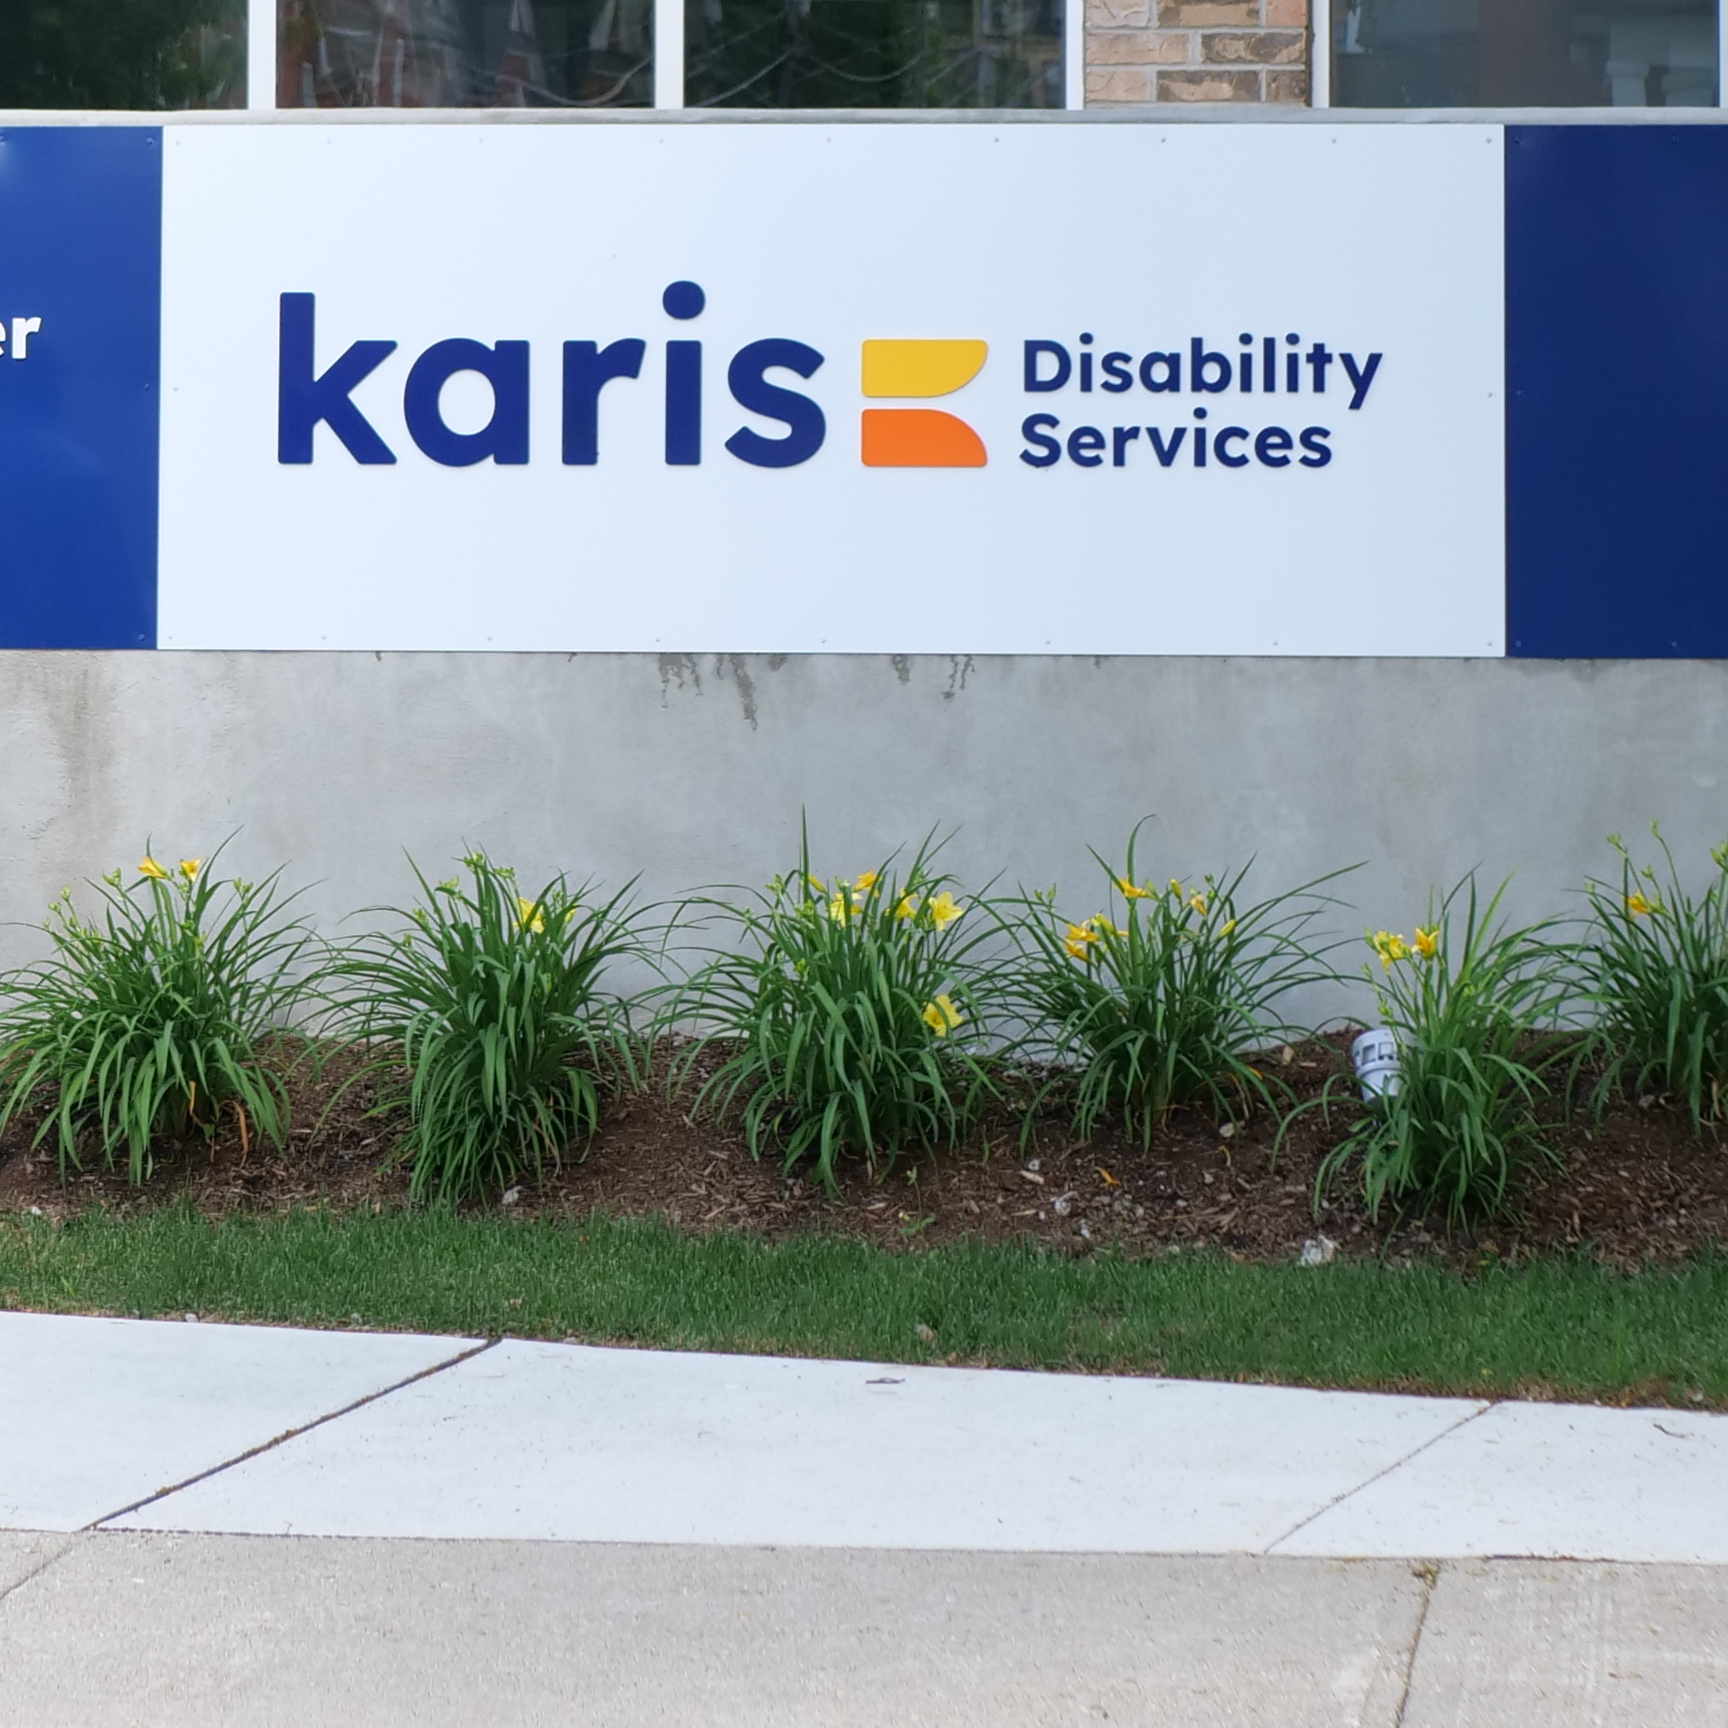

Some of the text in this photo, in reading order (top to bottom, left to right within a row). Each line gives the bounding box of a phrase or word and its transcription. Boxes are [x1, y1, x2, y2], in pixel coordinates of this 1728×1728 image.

[276, 280, 828, 469] karis
[1022, 332, 1384, 411] Disability
[1019, 406, 1334, 470] Services
